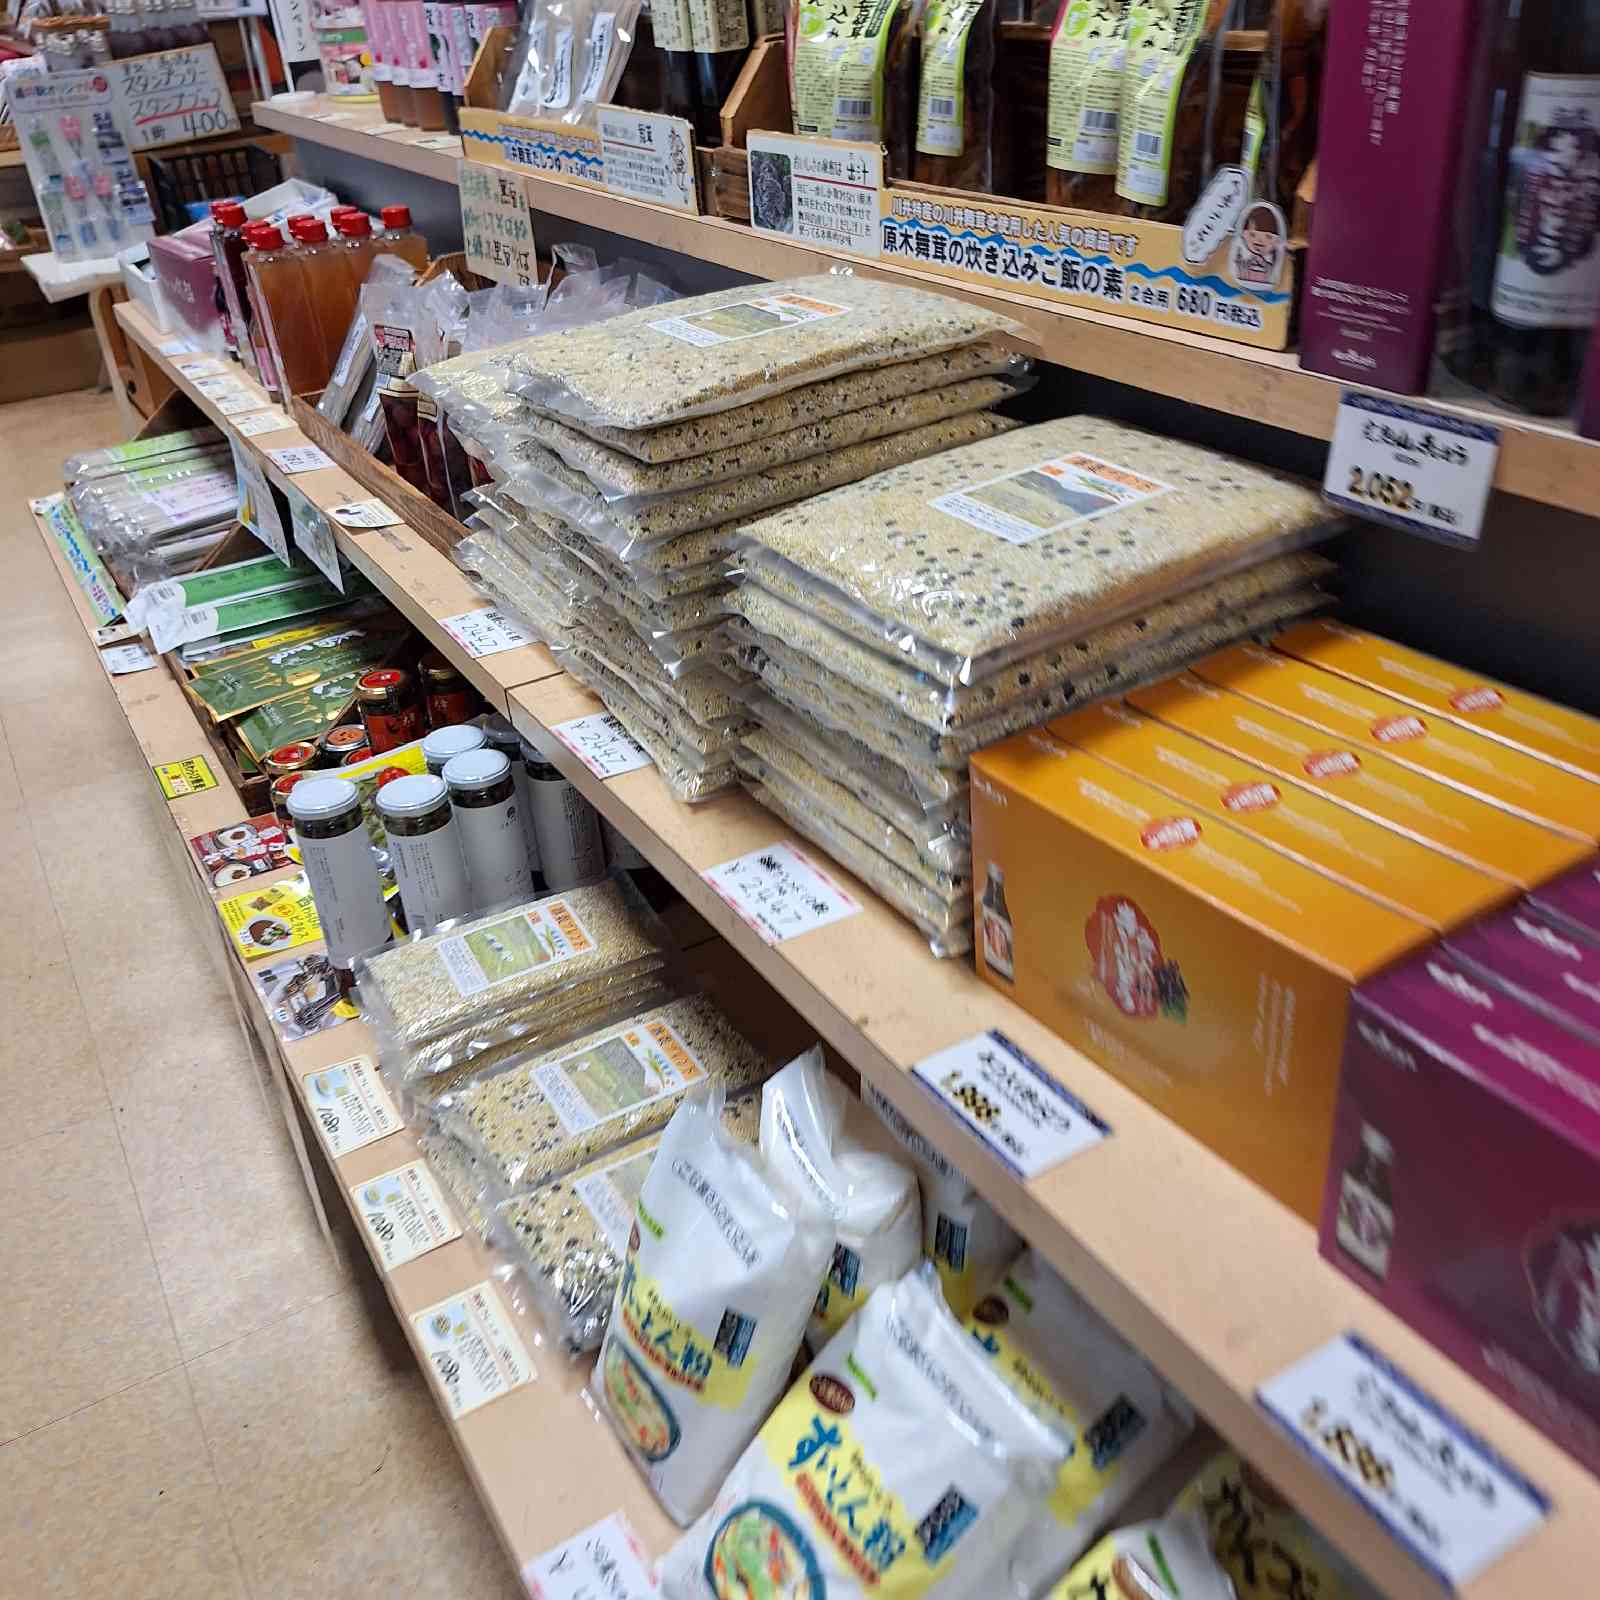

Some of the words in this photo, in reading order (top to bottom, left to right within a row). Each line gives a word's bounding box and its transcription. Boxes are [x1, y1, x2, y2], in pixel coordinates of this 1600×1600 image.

[182, 110, 229, 137] 400
[883, 224, 1124, 300] 原木舞茸の炊き込みご飯の素
[789, 1415, 906, 1573] すいとん粉
